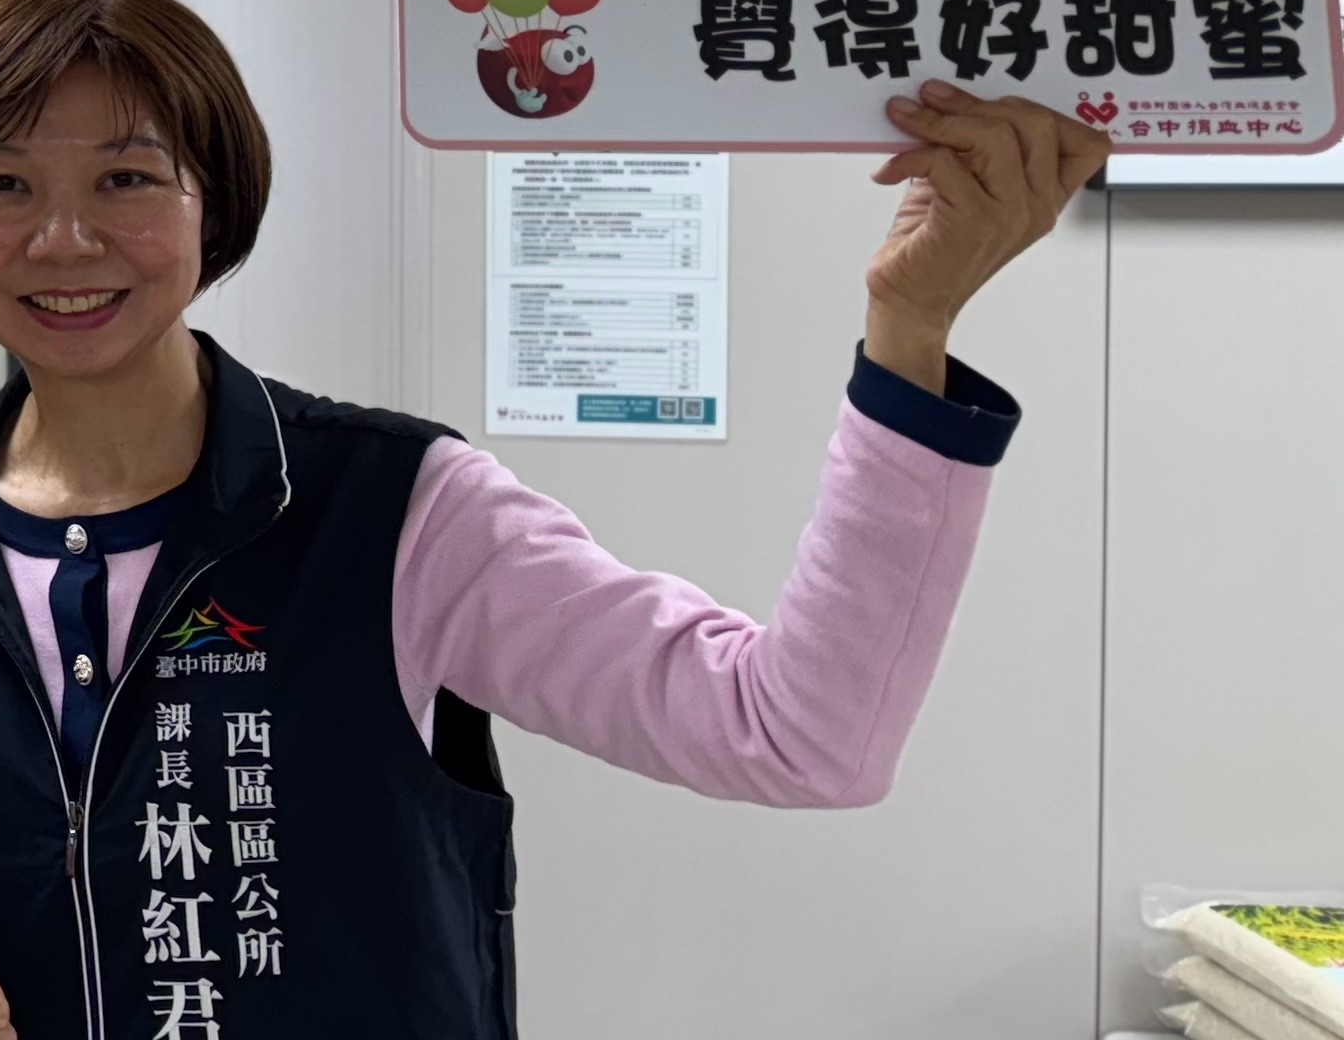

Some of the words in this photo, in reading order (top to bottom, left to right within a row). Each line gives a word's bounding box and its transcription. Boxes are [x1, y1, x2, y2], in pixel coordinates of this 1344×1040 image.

[1127, 118, 1304, 138] 台中捐血中心
[155, 651, 268, 679] 臺中市政府
[222, 709, 285, 978] 西區區公所
